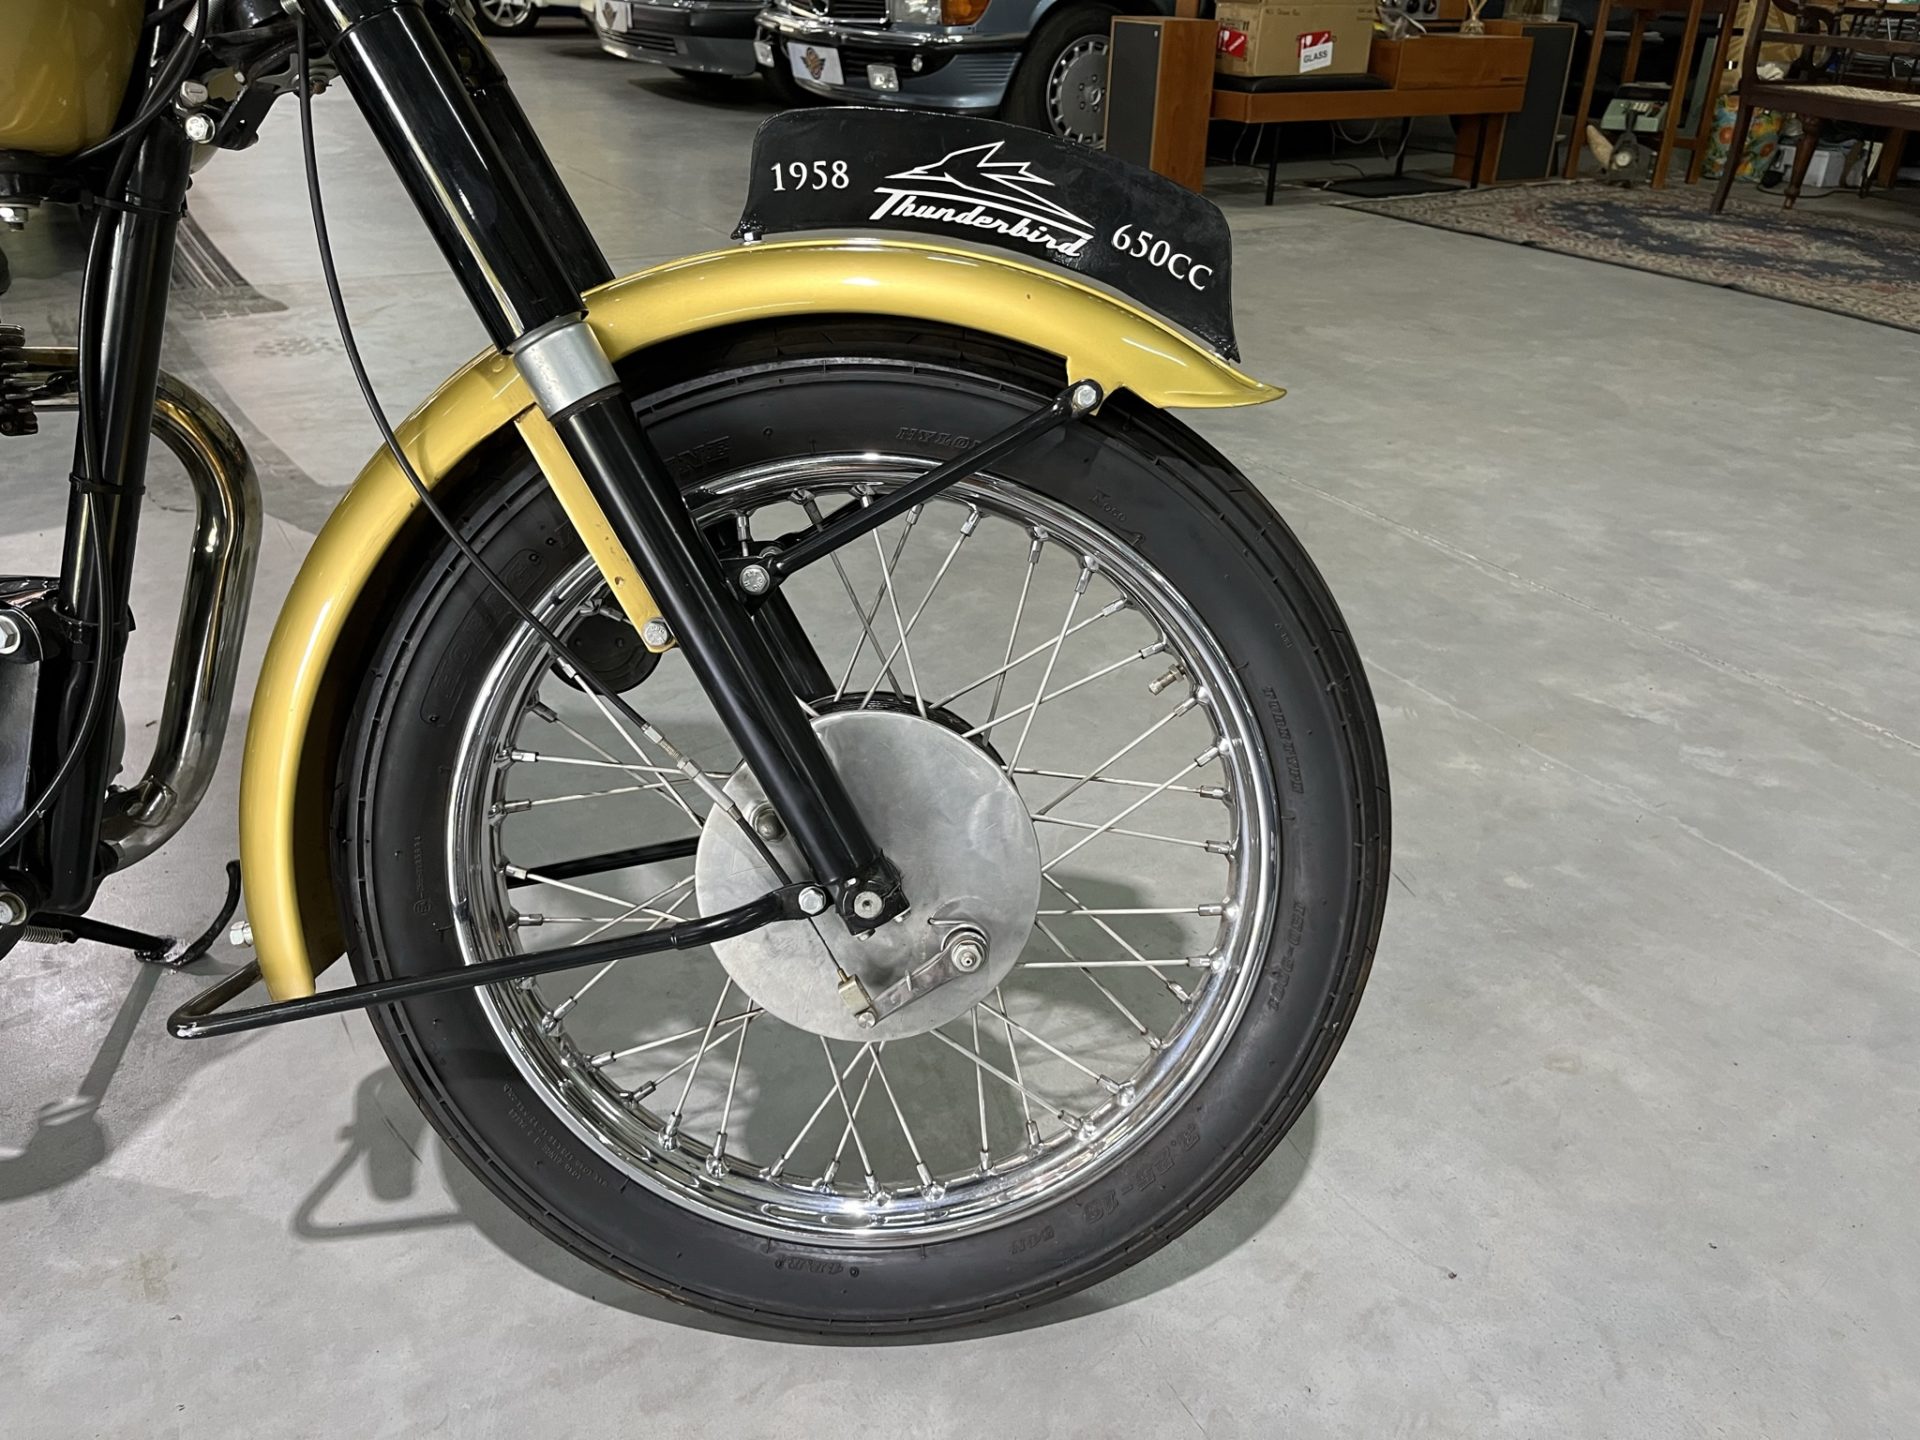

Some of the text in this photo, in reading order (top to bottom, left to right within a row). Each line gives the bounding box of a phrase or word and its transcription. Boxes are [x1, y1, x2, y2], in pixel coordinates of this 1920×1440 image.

[1303, 50, 1328, 63] GLASS
[770, 160, 850, 192] 1958
[868, 186, 1096, 258] Thunderbird
[1111, 224, 1214, 291] 650CC
